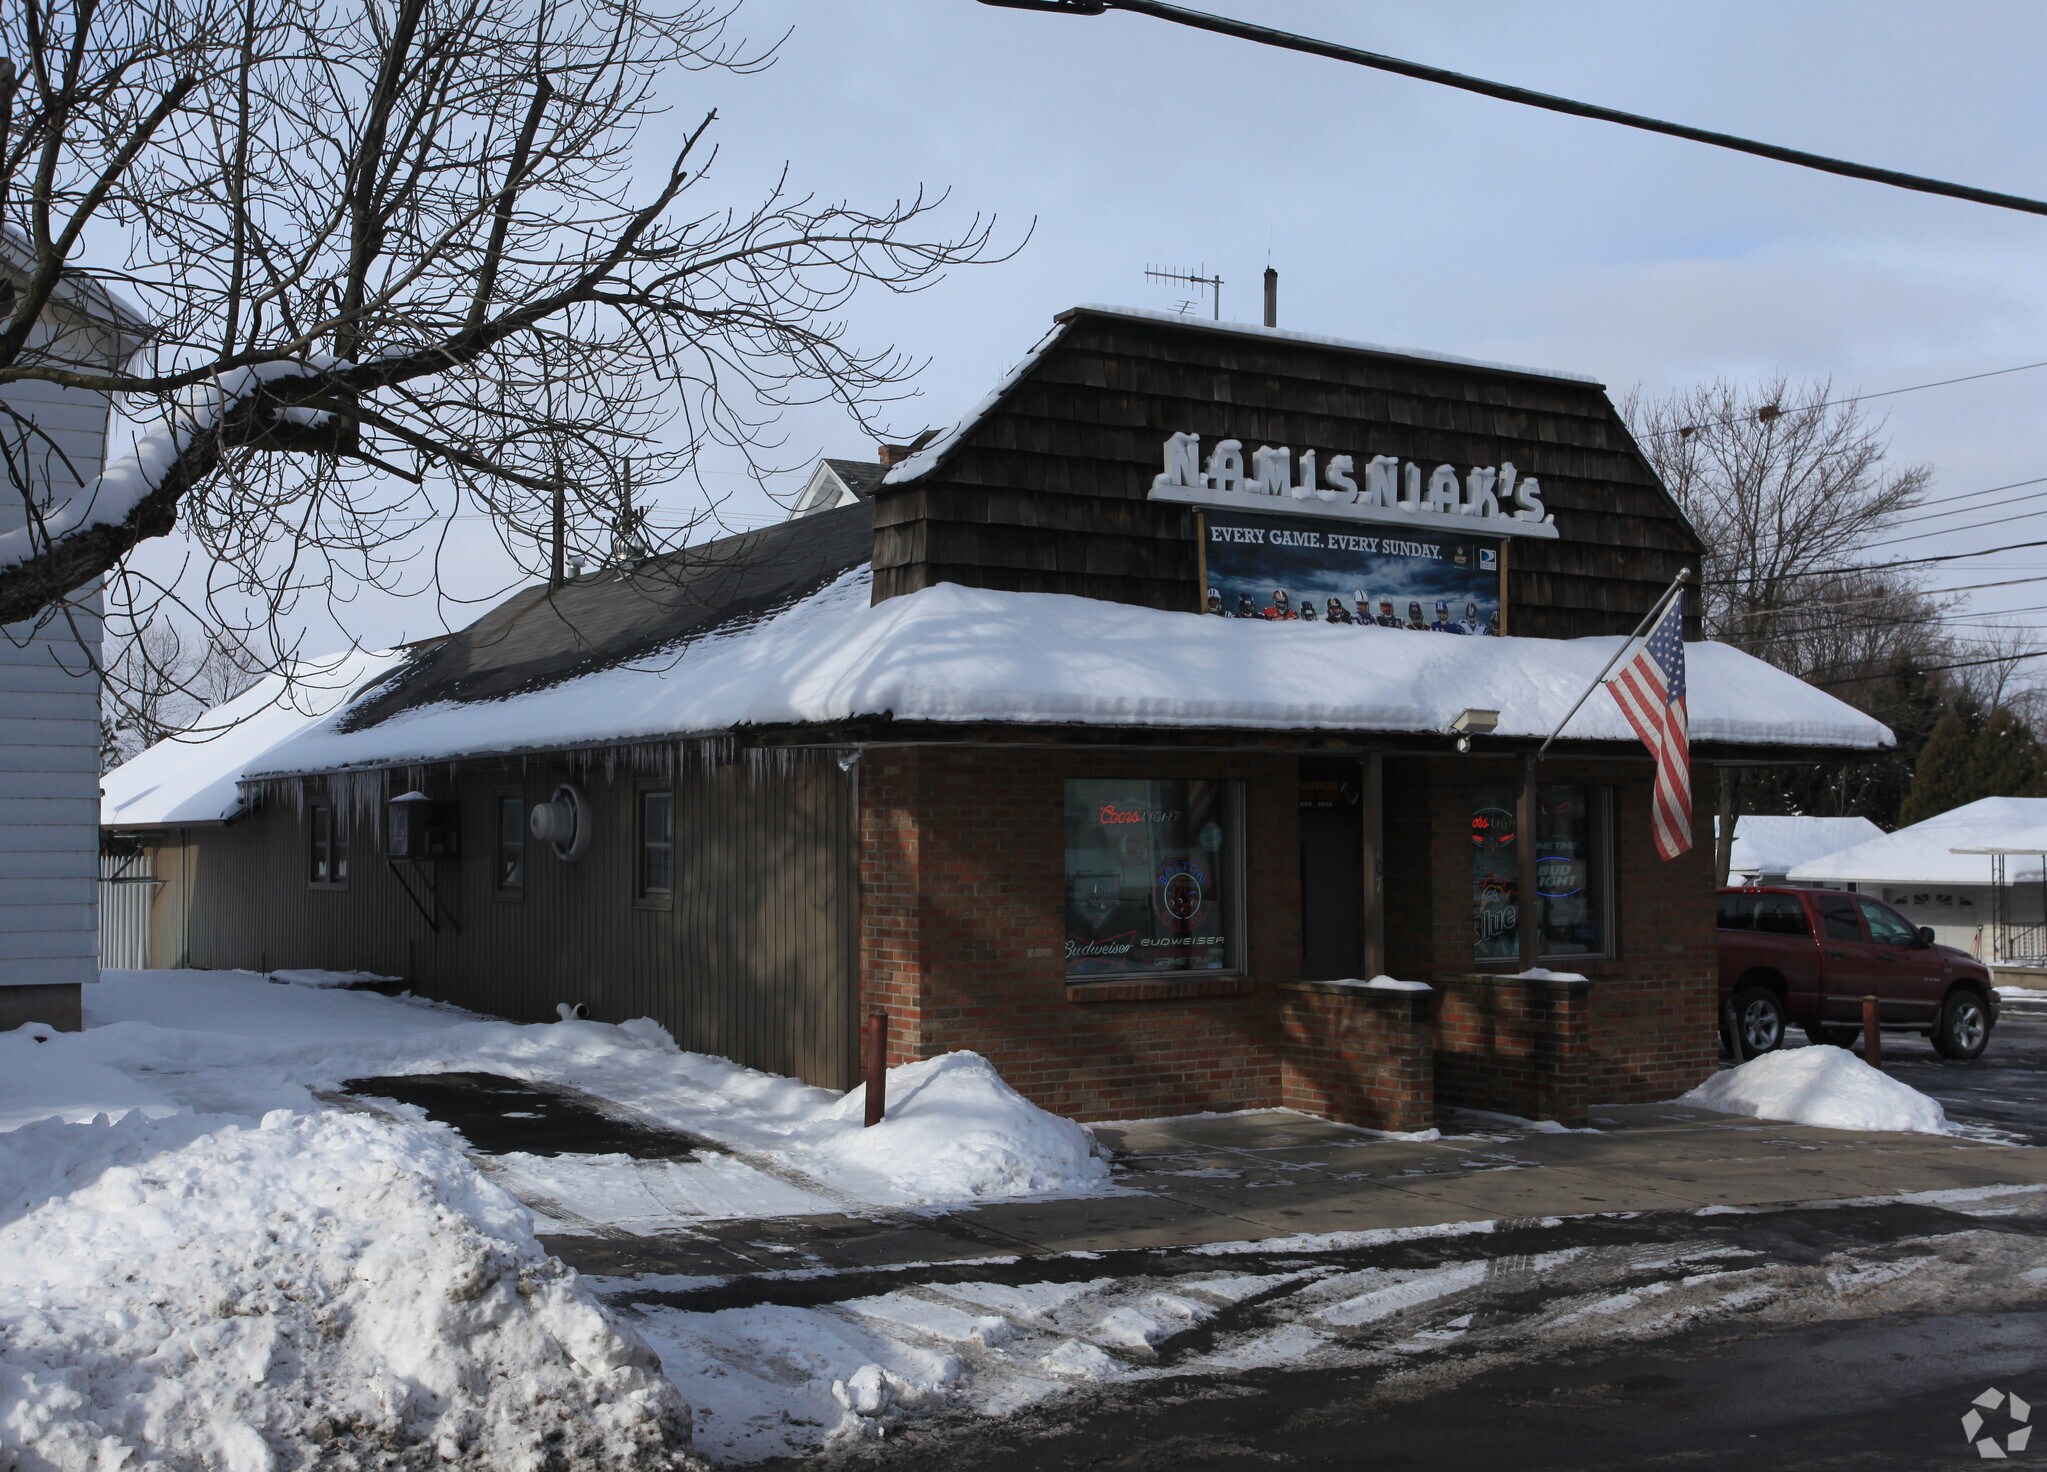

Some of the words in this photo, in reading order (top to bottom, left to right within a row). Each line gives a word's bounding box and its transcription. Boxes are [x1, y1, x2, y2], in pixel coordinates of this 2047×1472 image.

[1163, 432, 1546, 523] NAMISNIAK'S
[1210, 526, 1265, 543] EVERY
[1269, 530, 1325, 547] GAME.
[1328, 534, 1380, 552] EVERY
[1382, 539, 1443, 559] SUNDAY.
[1100, 804, 1142, 825] Coors
[1142, 811, 1184, 823] LIGHT
[1158, 861, 1206, 887] BOSTON
[1537, 864, 1572, 876] BUD
[1537, 876, 1578, 888] IGHT
[1064, 940, 1134, 958] Budweiser
[1141, 936, 1225, 947] BUDWEISER
